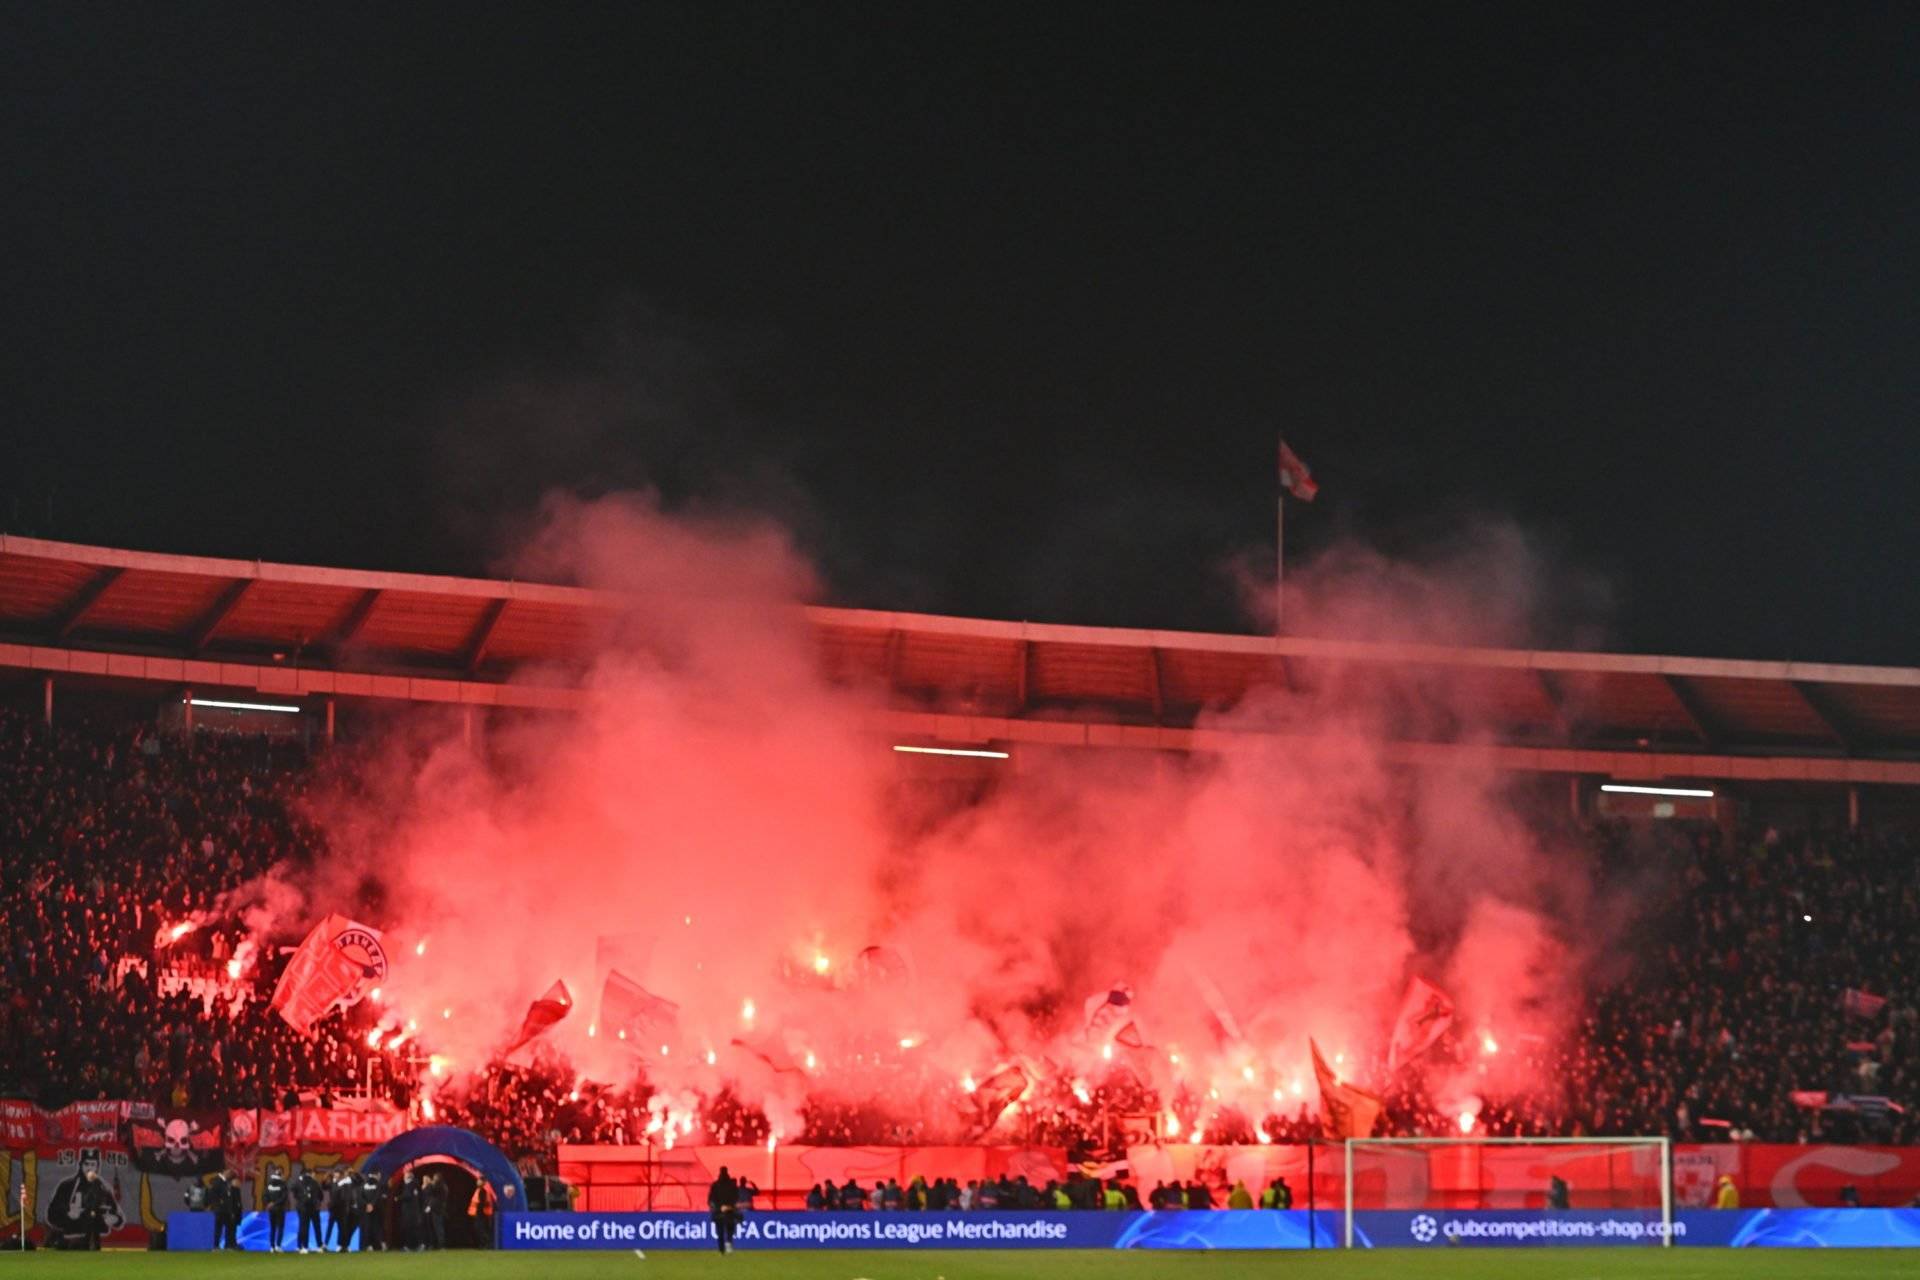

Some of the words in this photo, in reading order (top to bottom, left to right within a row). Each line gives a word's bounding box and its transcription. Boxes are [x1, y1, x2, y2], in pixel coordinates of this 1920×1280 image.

[516, 1221, 574, 1239] Home
[578, 1220, 600, 1239] of
[602, 1221, 635, 1239] the
[639, 1219, 706, 1239] Official
[711, 1220, 760, 1239] UFA
[763, 1220, 871, 1242] Champions
[874, 1221, 943, 1243] League
[947, 1220, 1067, 1239] Merchandise
[1443, 1219, 1686, 1240] clubcompetitions-shop.com
